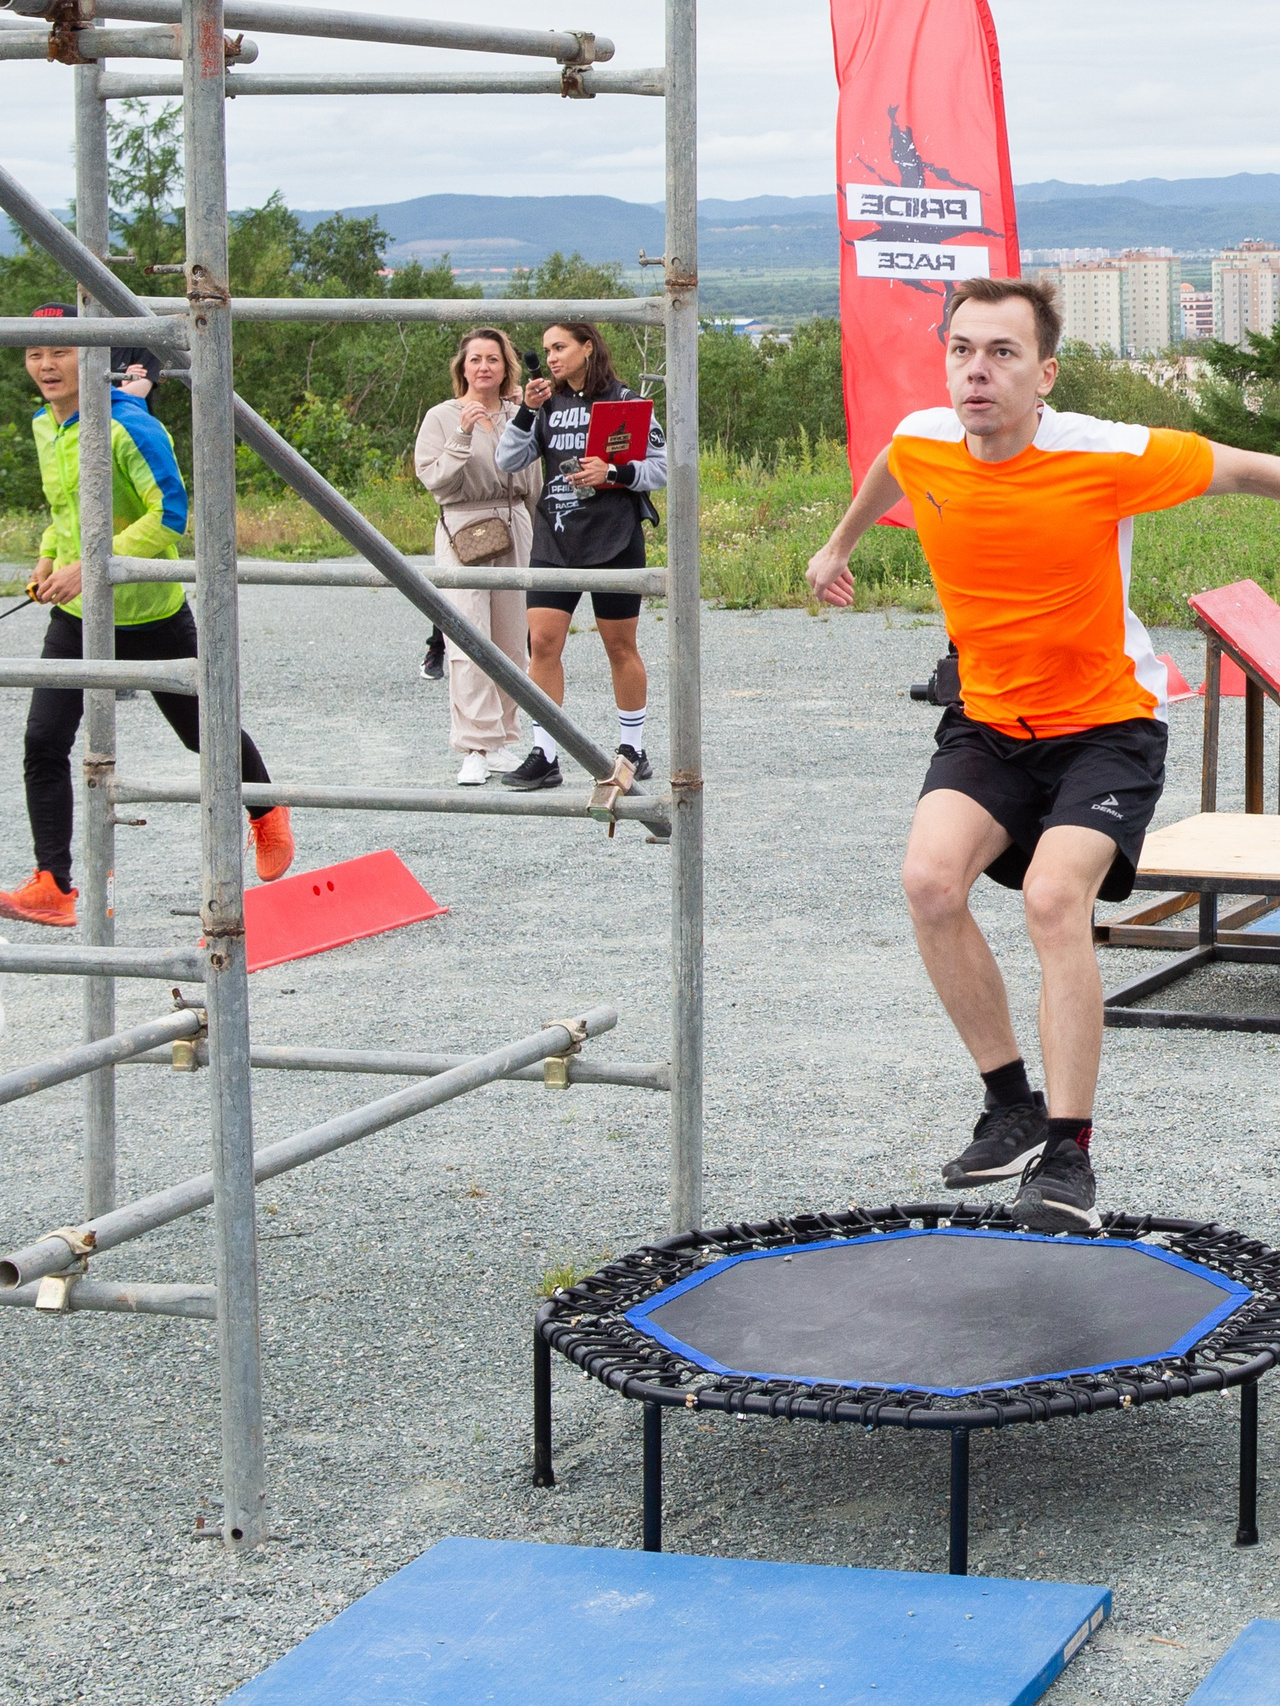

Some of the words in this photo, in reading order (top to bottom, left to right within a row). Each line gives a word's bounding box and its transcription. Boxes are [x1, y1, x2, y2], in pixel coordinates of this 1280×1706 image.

[548, 406, 591, 429] СУДЬ
[548, 432, 589, 451] JUDG
[551, 484, 574, 494] PRID
[1090, 803, 1124, 820] DEMIX
